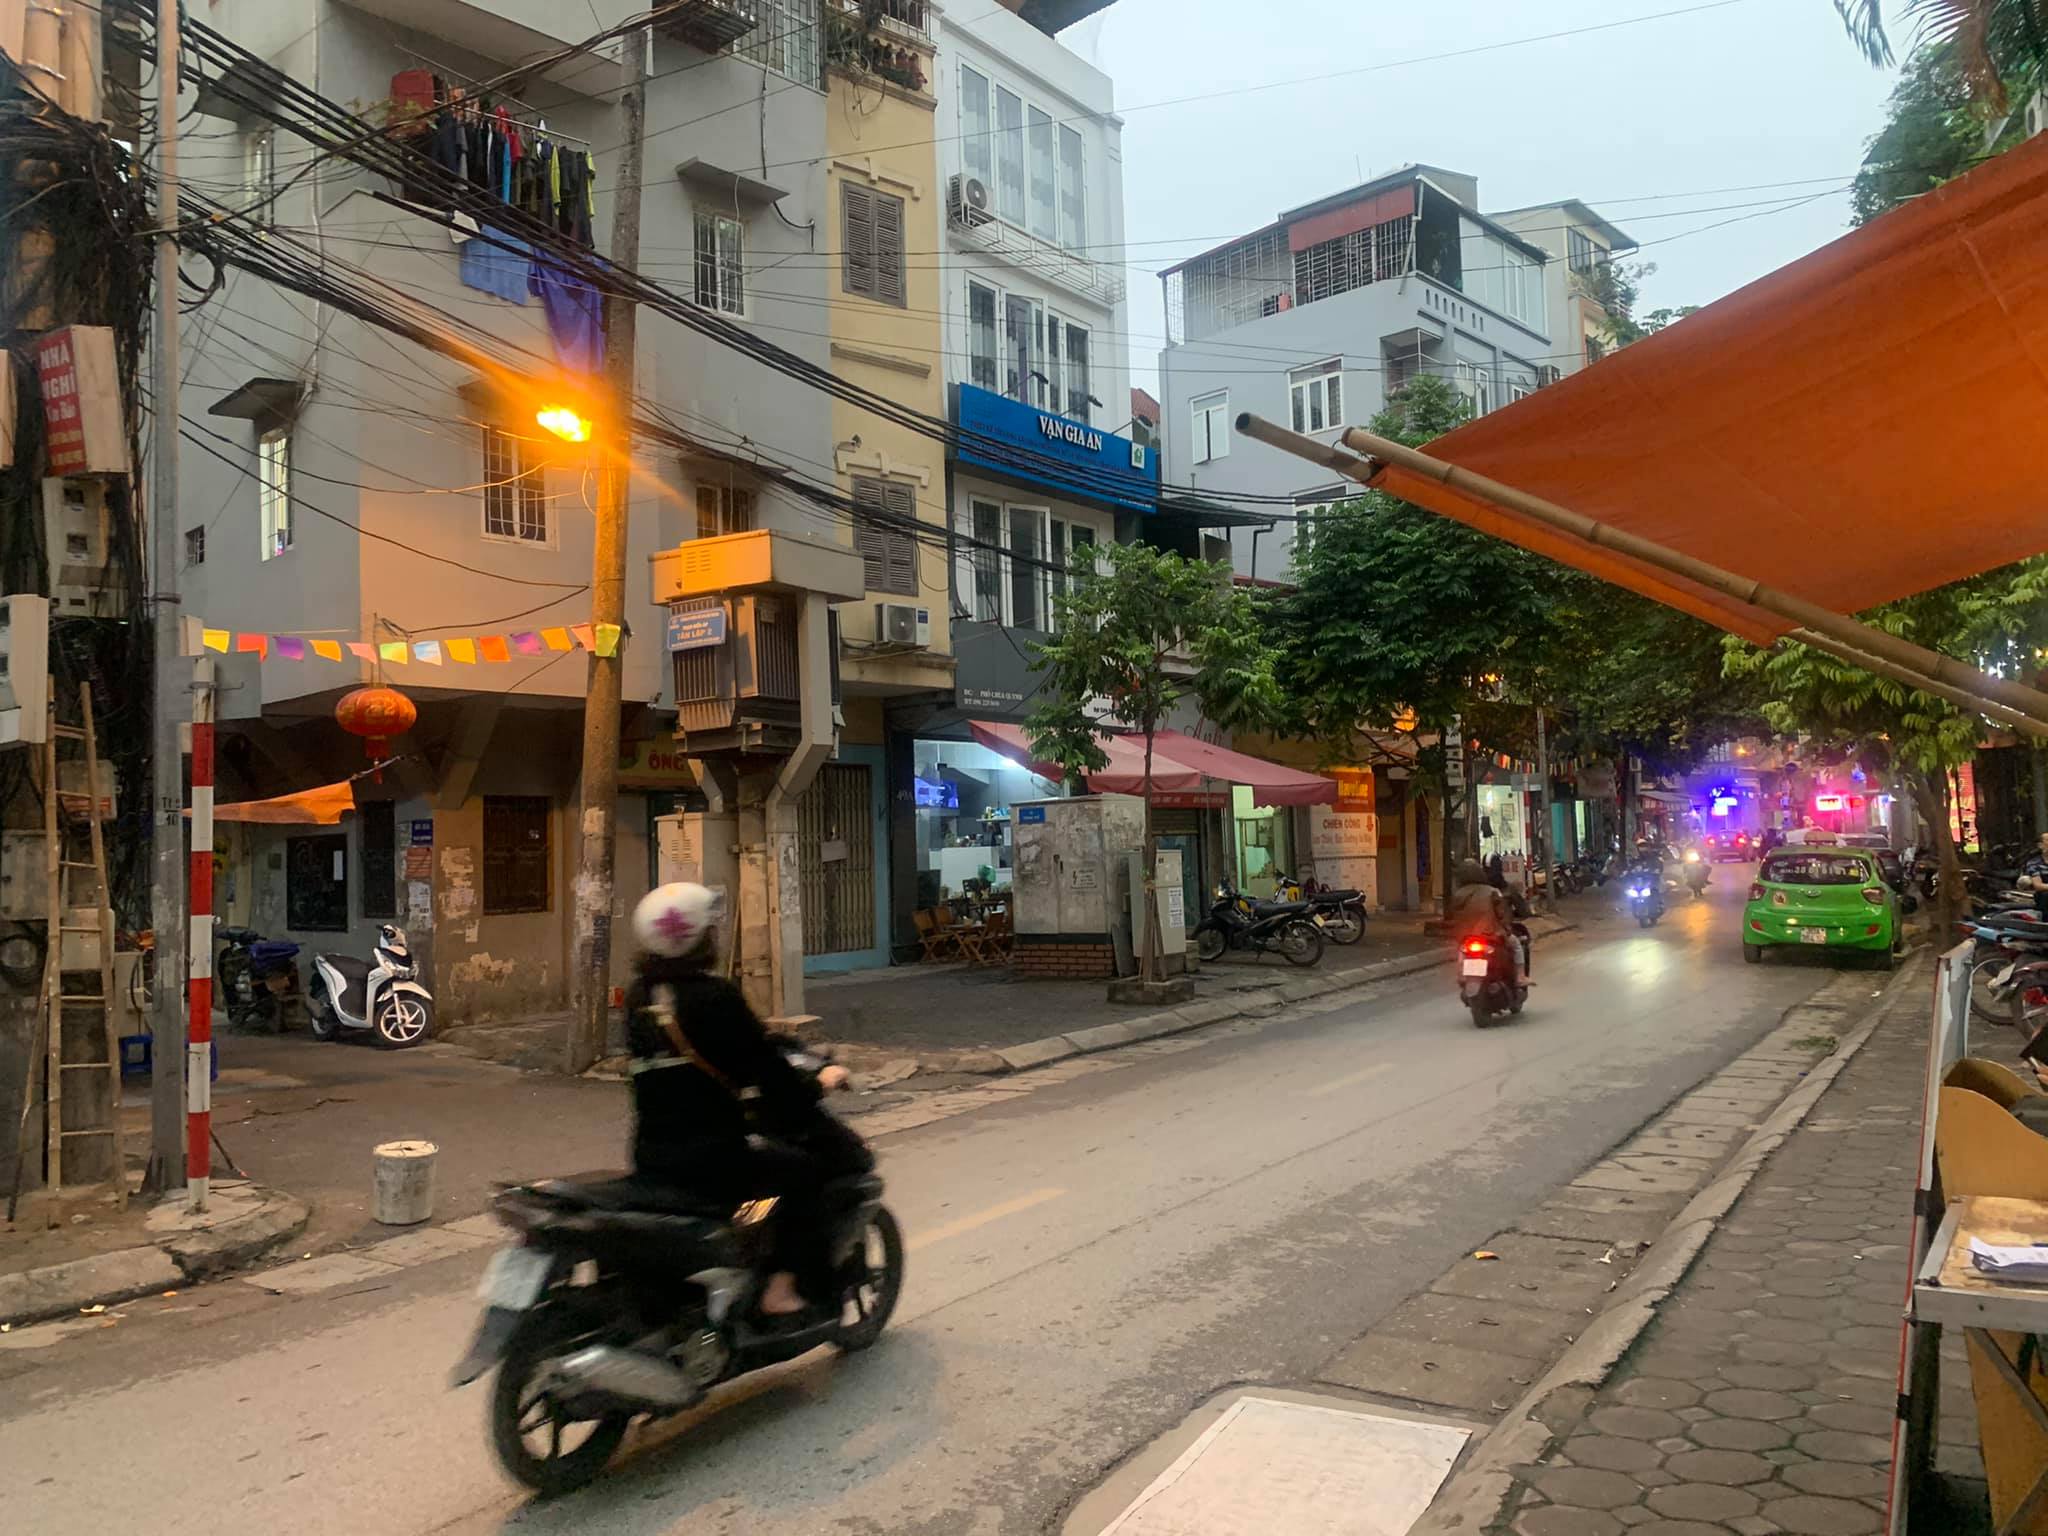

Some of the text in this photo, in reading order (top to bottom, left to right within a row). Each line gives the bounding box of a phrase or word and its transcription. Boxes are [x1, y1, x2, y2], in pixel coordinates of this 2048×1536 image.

[40, 340, 70, 370] NHÀ
[1039, 415, 1102, 452] VẠN GIA AN
